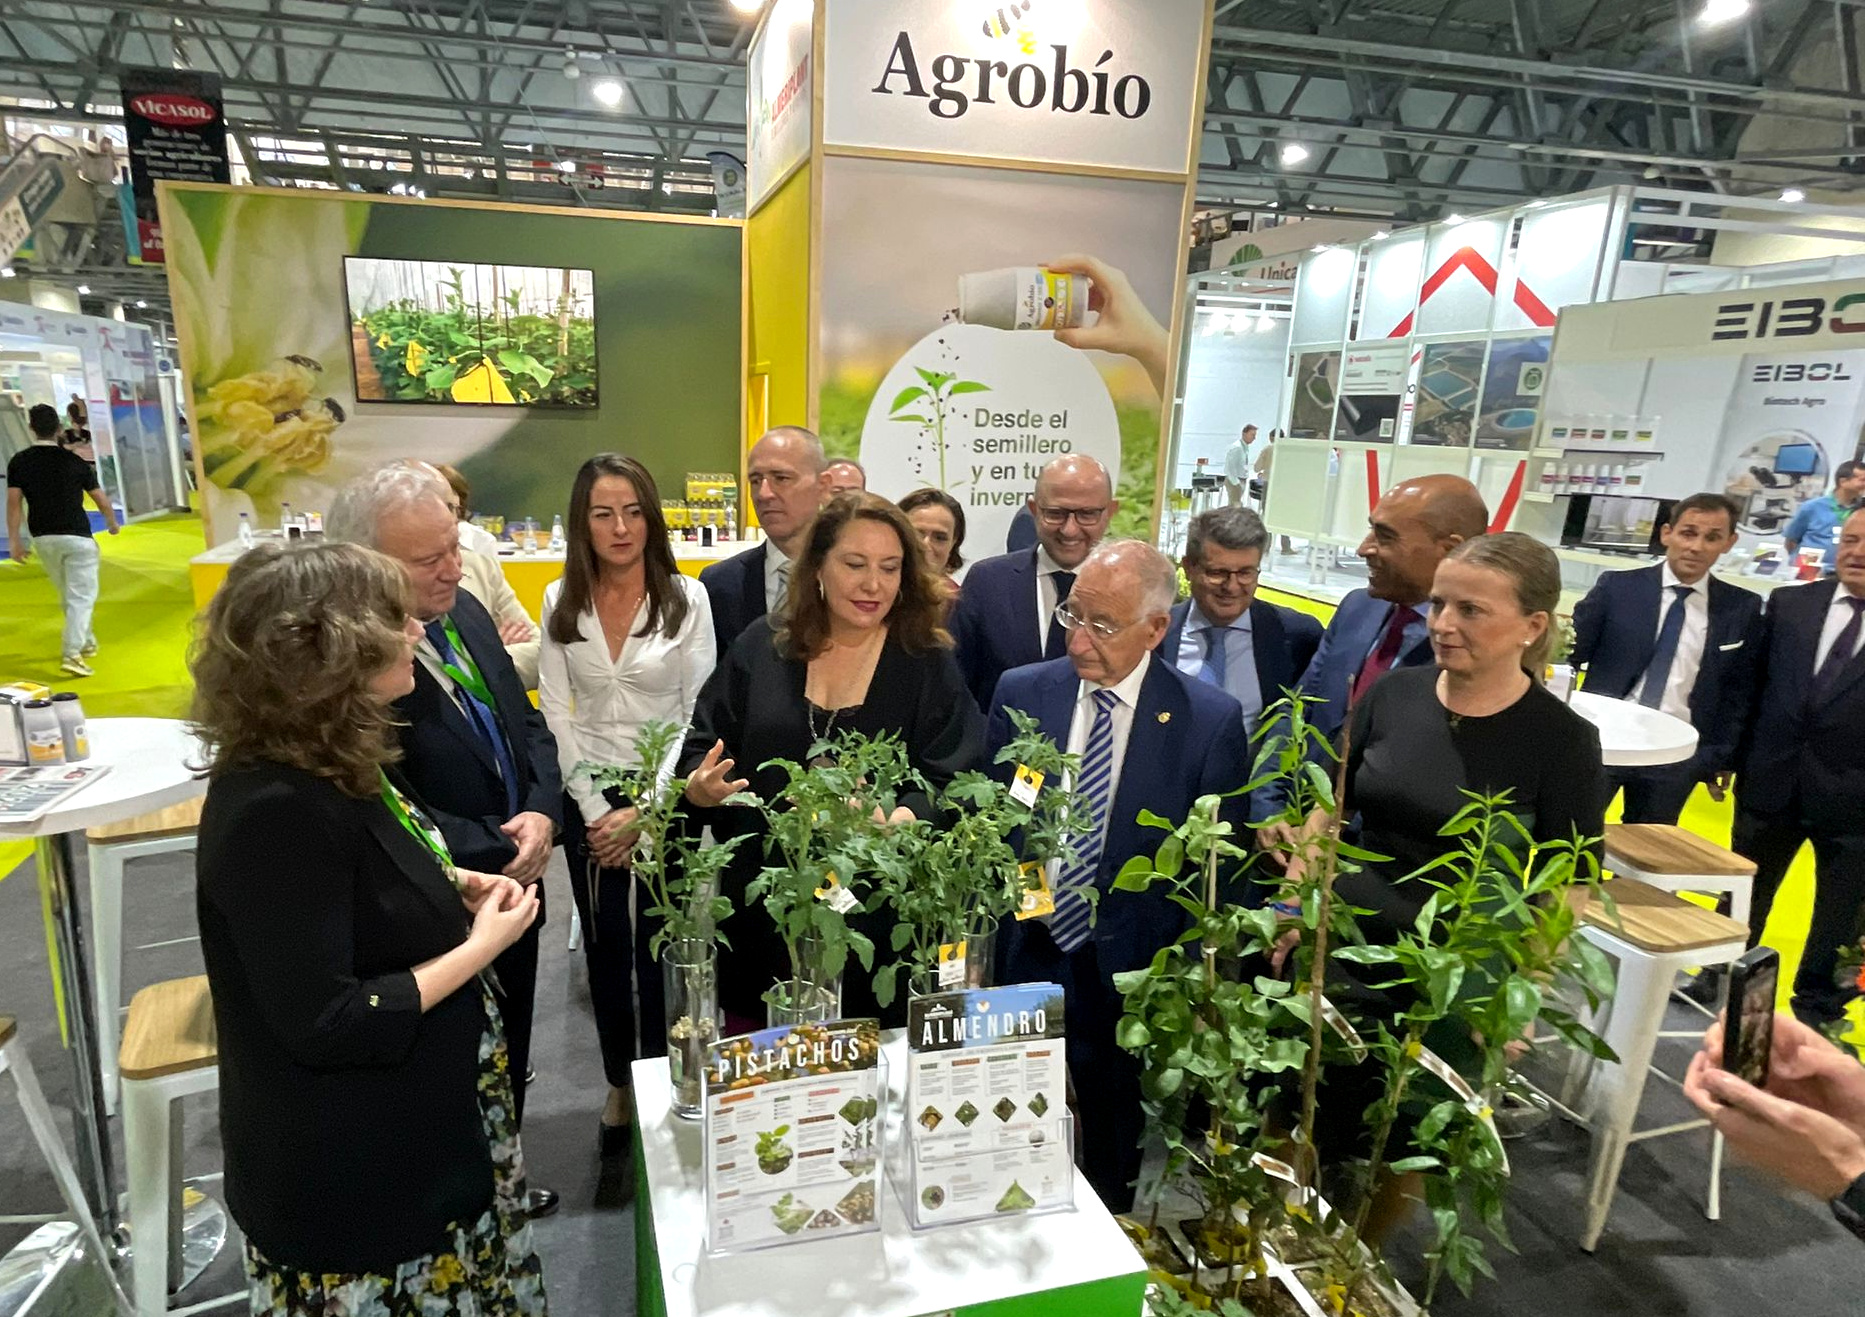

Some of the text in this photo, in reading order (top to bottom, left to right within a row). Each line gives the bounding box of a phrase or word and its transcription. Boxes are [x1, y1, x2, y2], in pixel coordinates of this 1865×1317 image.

[872, 31, 1151, 118] Agrobío
[135, 100, 211, 119] VICASOL
[1753, 363, 1851, 382] EIBOL
[974, 408, 1068, 429] Desde el
[972, 434, 1072, 454] semillero
[972, 465, 983, 485] y
[990, 465, 1016, 480] en
[922, 1009, 1046, 1045] ALMENDRO
[718, 1038, 860, 1083] PISTACHOS
